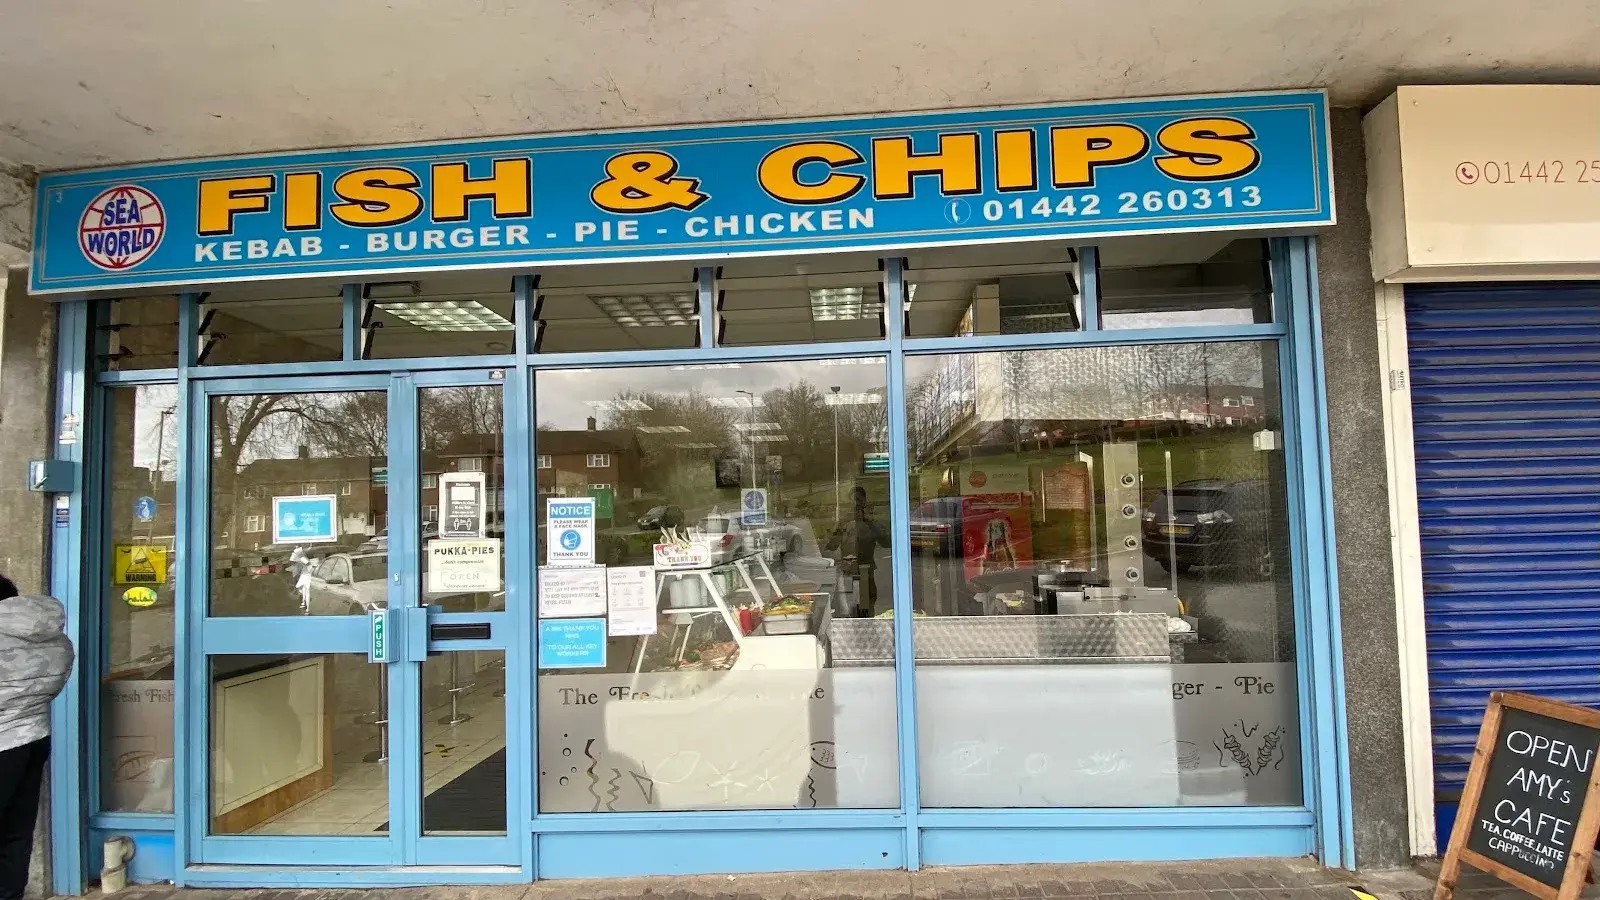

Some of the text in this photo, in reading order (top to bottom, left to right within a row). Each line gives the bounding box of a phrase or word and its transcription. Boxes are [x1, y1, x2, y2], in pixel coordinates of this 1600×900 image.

[197, 115, 1262, 236] FISH & CHIPS
[1484, 160, 1566, 184] 01442
[103, 199, 140, 226] SEA
[983, 186, 1262, 222] 01442 260313
[88, 228, 155, 256] WORLD
[195, 236, 323, 262] KEBAB
[367, 225, 530, 253] BURGER
[575, 220, 639, 242] PIE
[685, 207, 875, 238] CHICKEN
[551, 506, 591, 516] NOTICE
[126, 574, 156, 582] WARNING
[558, 687, 598, 706] The
[1234, 676, 1275, 694] Pie
[1507, 730, 1593, 772] OPEN
[1494, 799, 1571, 846] CAFE
